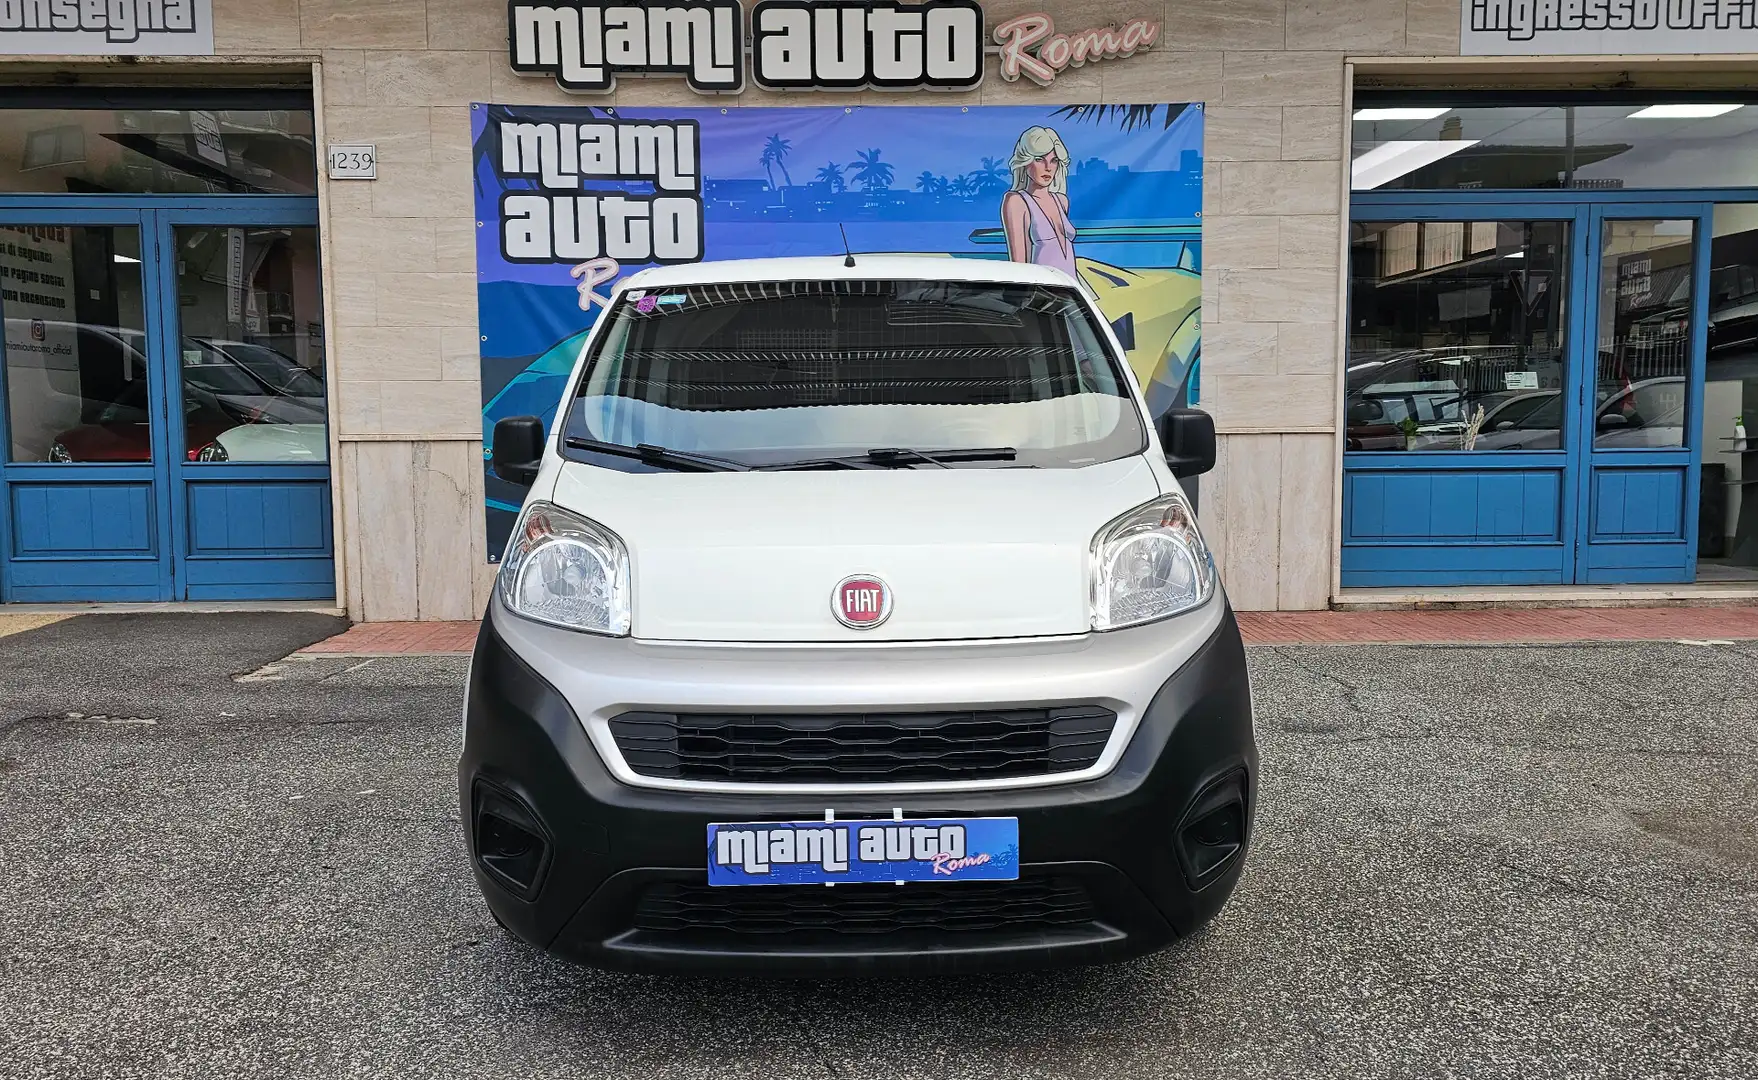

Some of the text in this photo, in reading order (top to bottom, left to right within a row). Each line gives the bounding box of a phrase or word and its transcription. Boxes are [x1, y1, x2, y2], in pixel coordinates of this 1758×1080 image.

[1666, 0, 1758, 29] uffi
[514, 5, 978, 83] miami auto
[997, 13, 1160, 82] Roma
[332, 152, 373, 170] 1239
[500, 121, 696, 190] miami
[503, 195, 700, 260] auto
[846, 589, 879, 612] FIAT
[716, 826, 965, 873] miami auto
[930, 851, 991, 876] Roma
